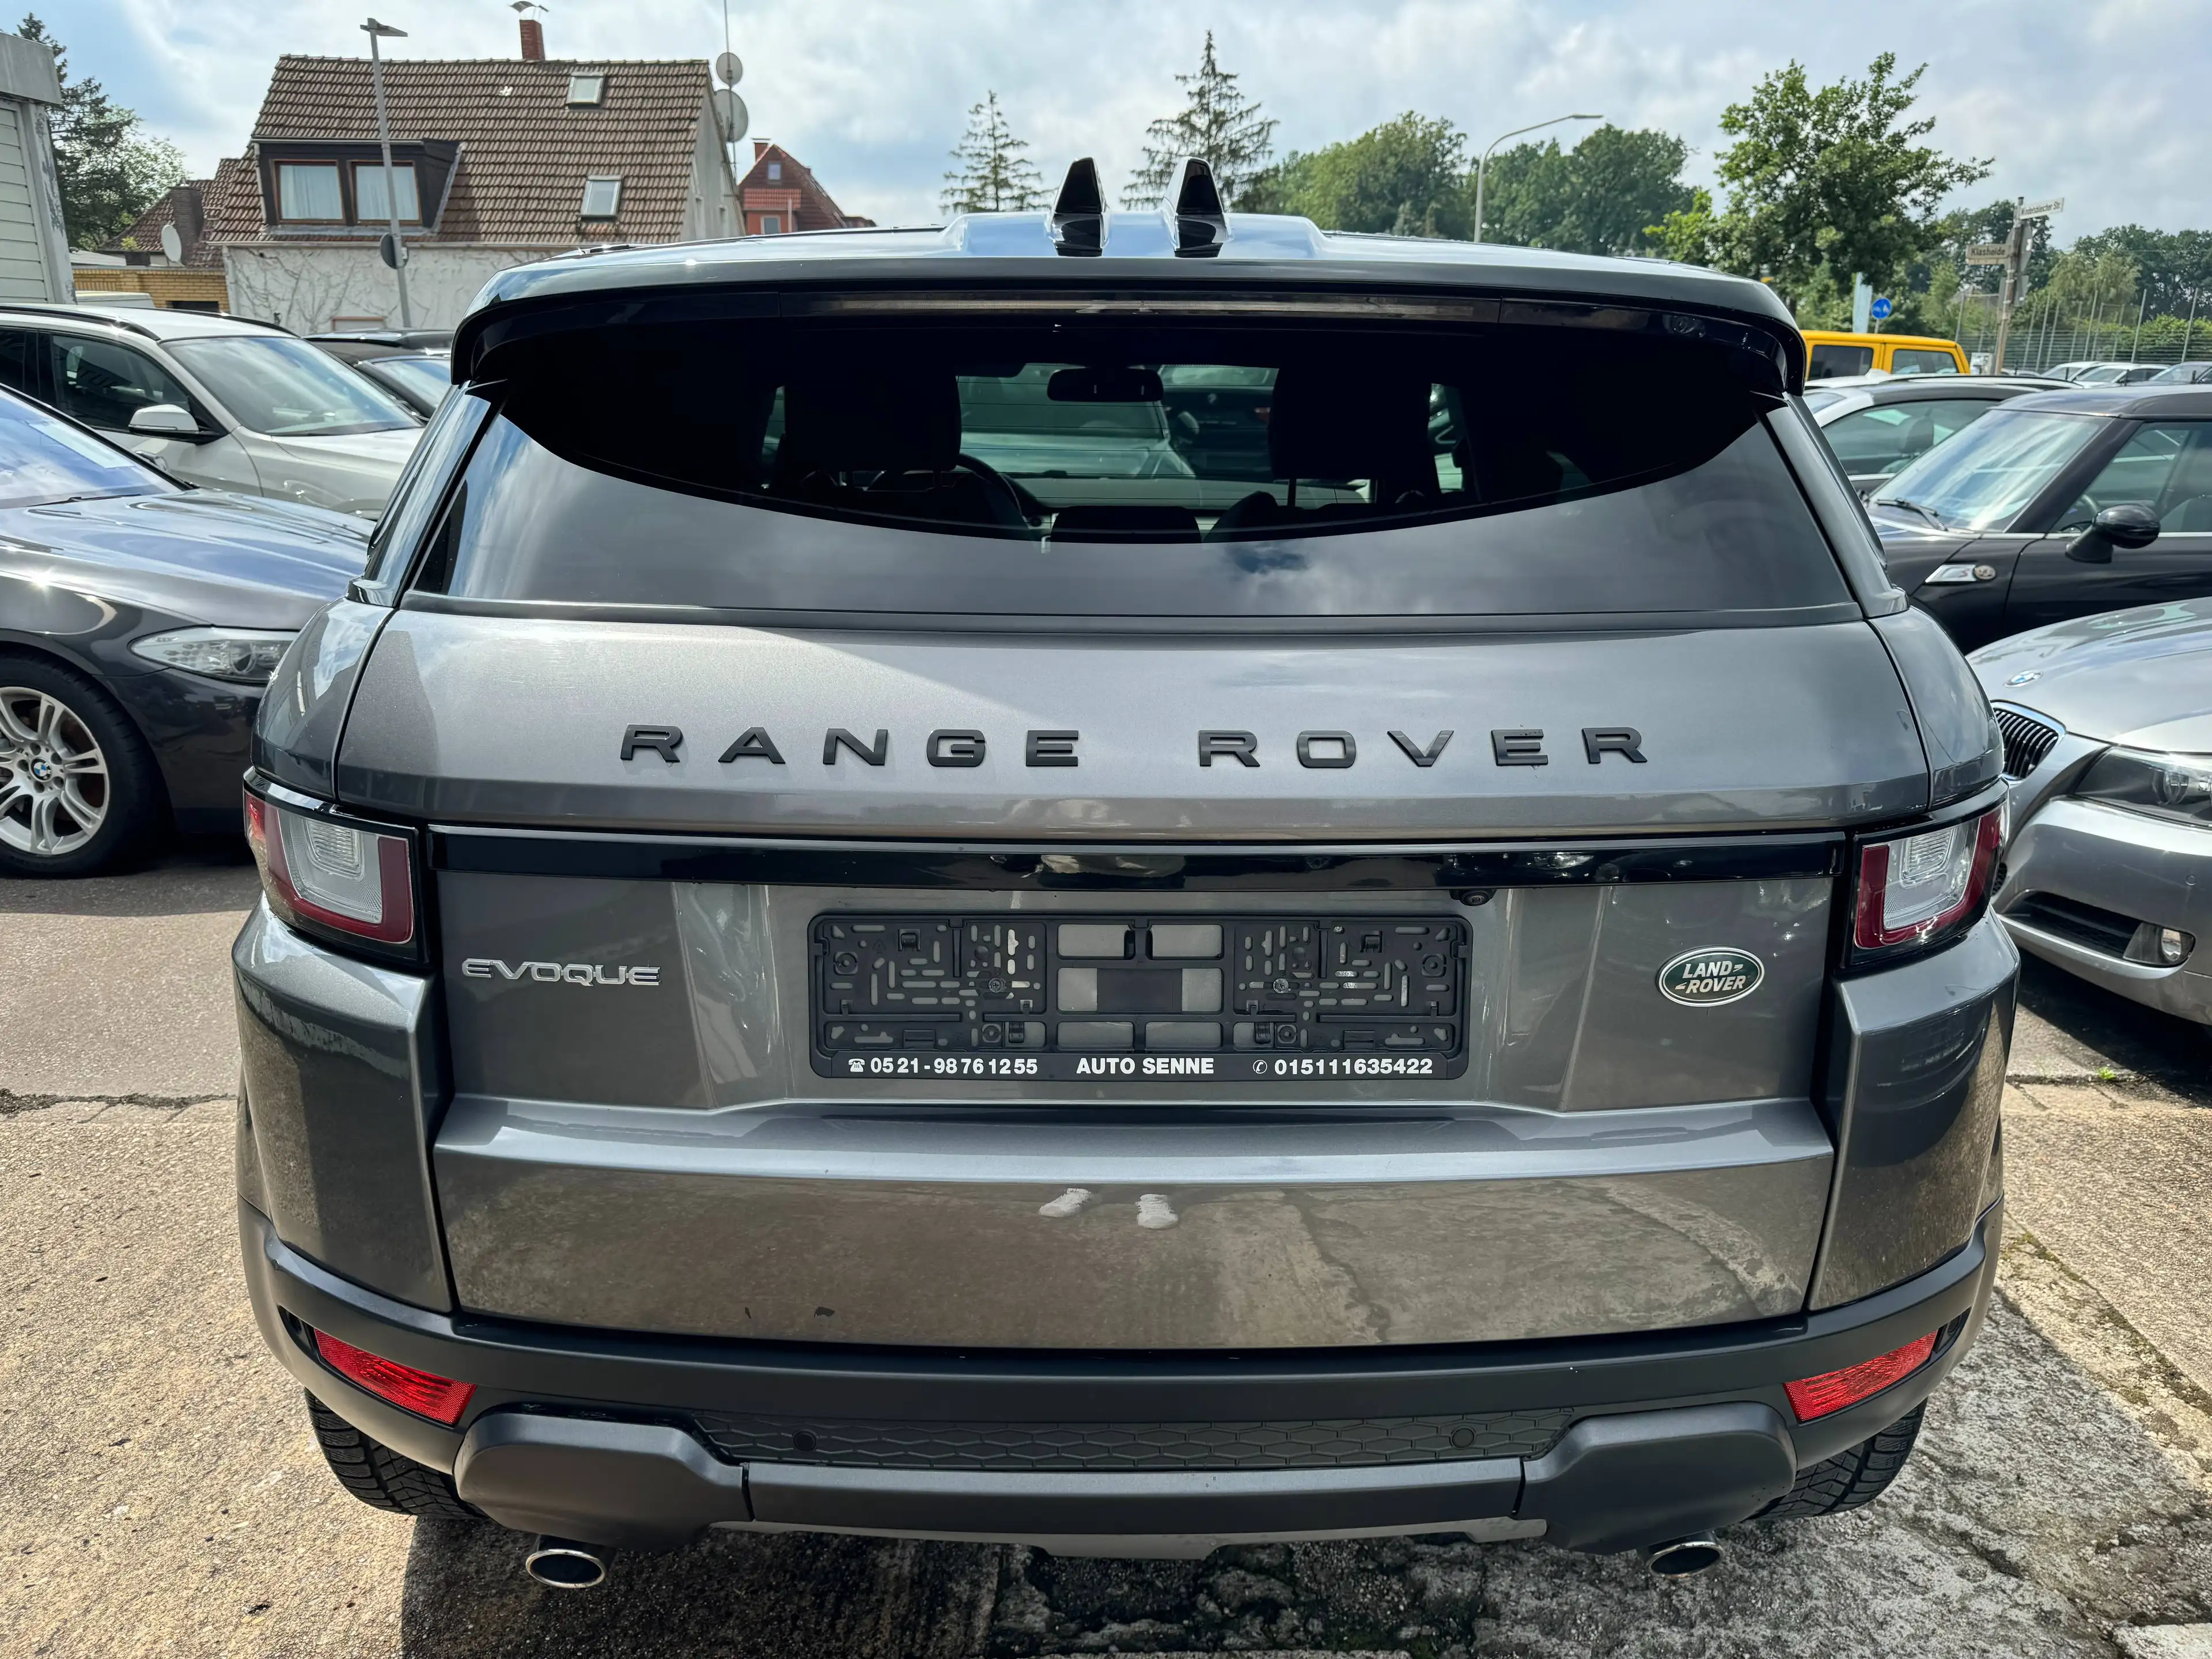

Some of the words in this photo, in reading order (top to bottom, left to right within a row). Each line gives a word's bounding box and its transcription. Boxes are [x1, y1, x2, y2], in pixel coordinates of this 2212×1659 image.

[620, 724, 1079, 767] RANGE
[1198, 726, 1647, 768] ROVER
[462, 958, 661, 986] EVOQUE
[1682, 960, 1732, 979] LAND
[1685, 975, 1746, 994] ROVER
[1076, 1058, 1135, 1074] AUTO
[1142, 1058, 1214, 1074] SENNE
[1274, 1058, 1433, 1075] 015111635422
